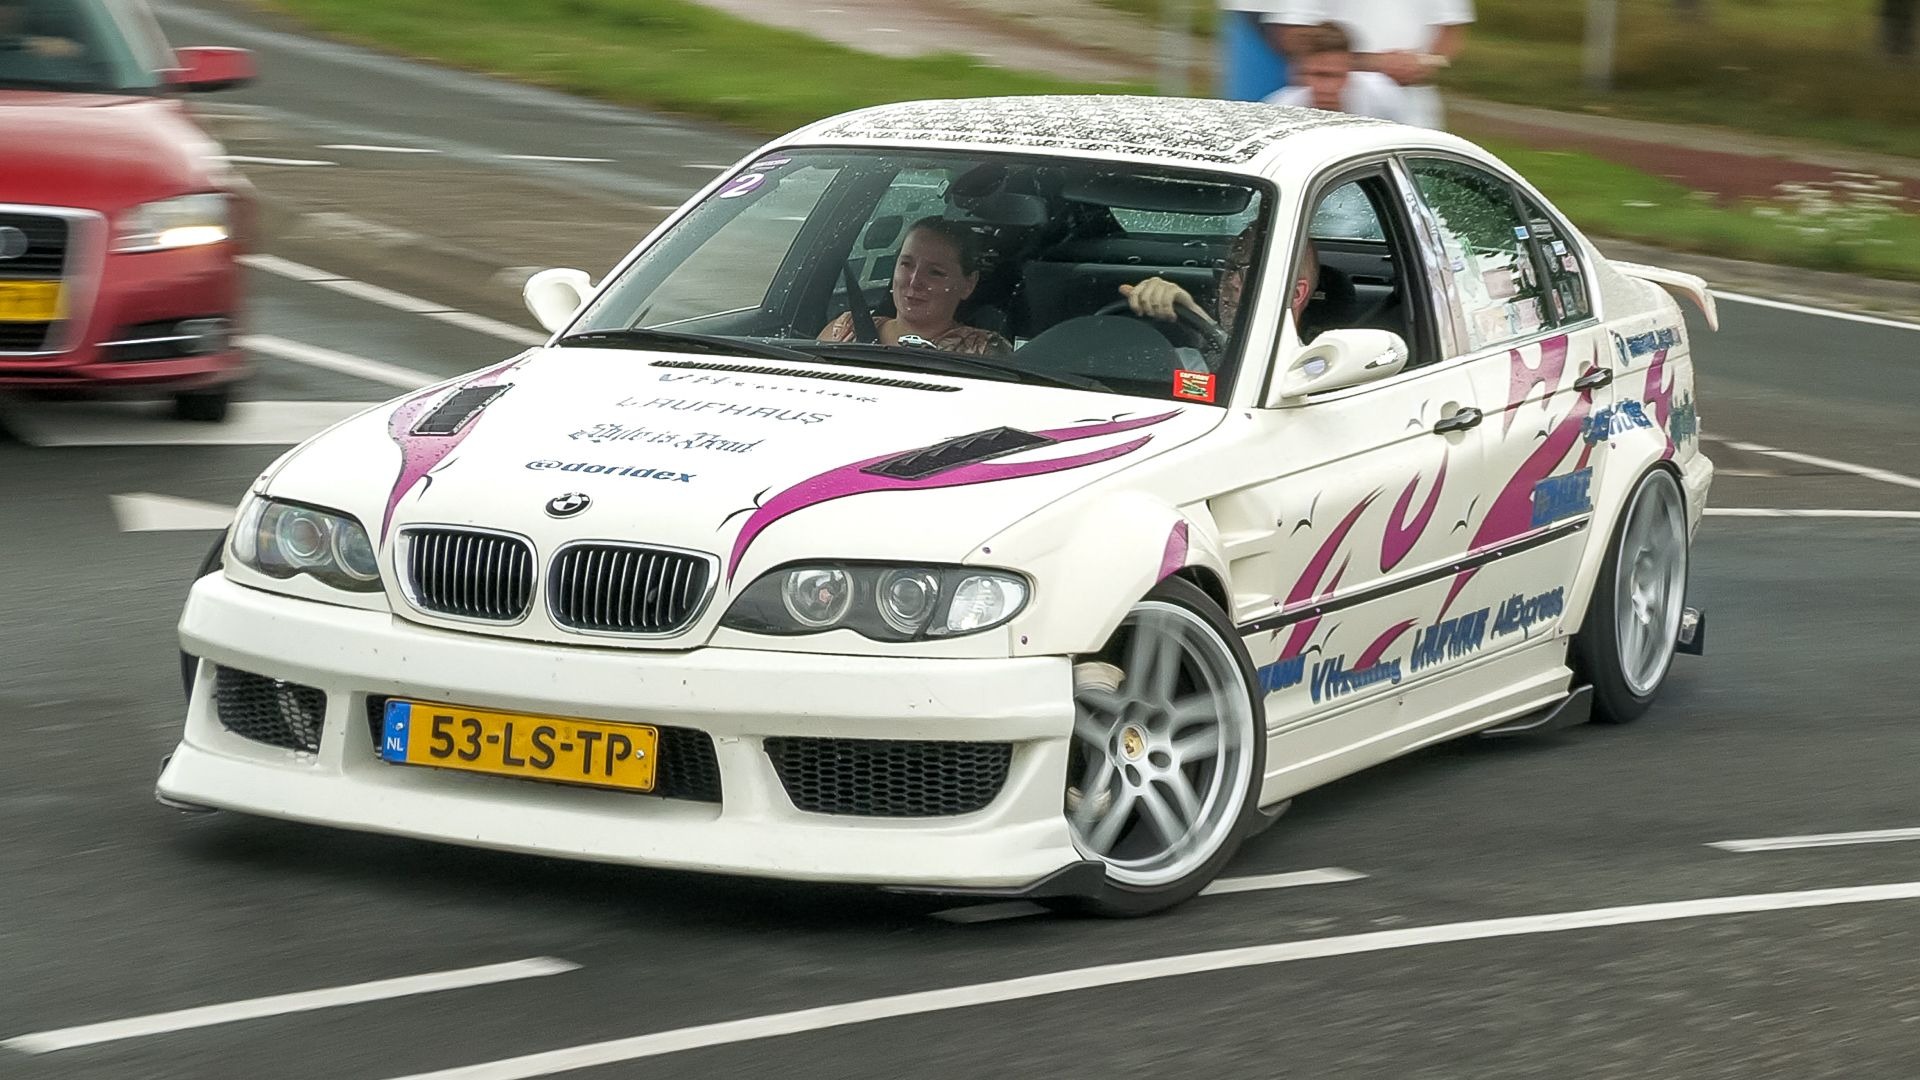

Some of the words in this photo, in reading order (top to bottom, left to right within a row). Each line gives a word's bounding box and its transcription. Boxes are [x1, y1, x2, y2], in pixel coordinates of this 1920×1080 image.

[719, 173, 765, 198] 2
[615, 395, 833, 425] LAUFHAUS
[525, 459, 697, 483] @doridex
[386, 736, 404, 753] NL
[429, 715, 632, 776] 53-LS-TP
